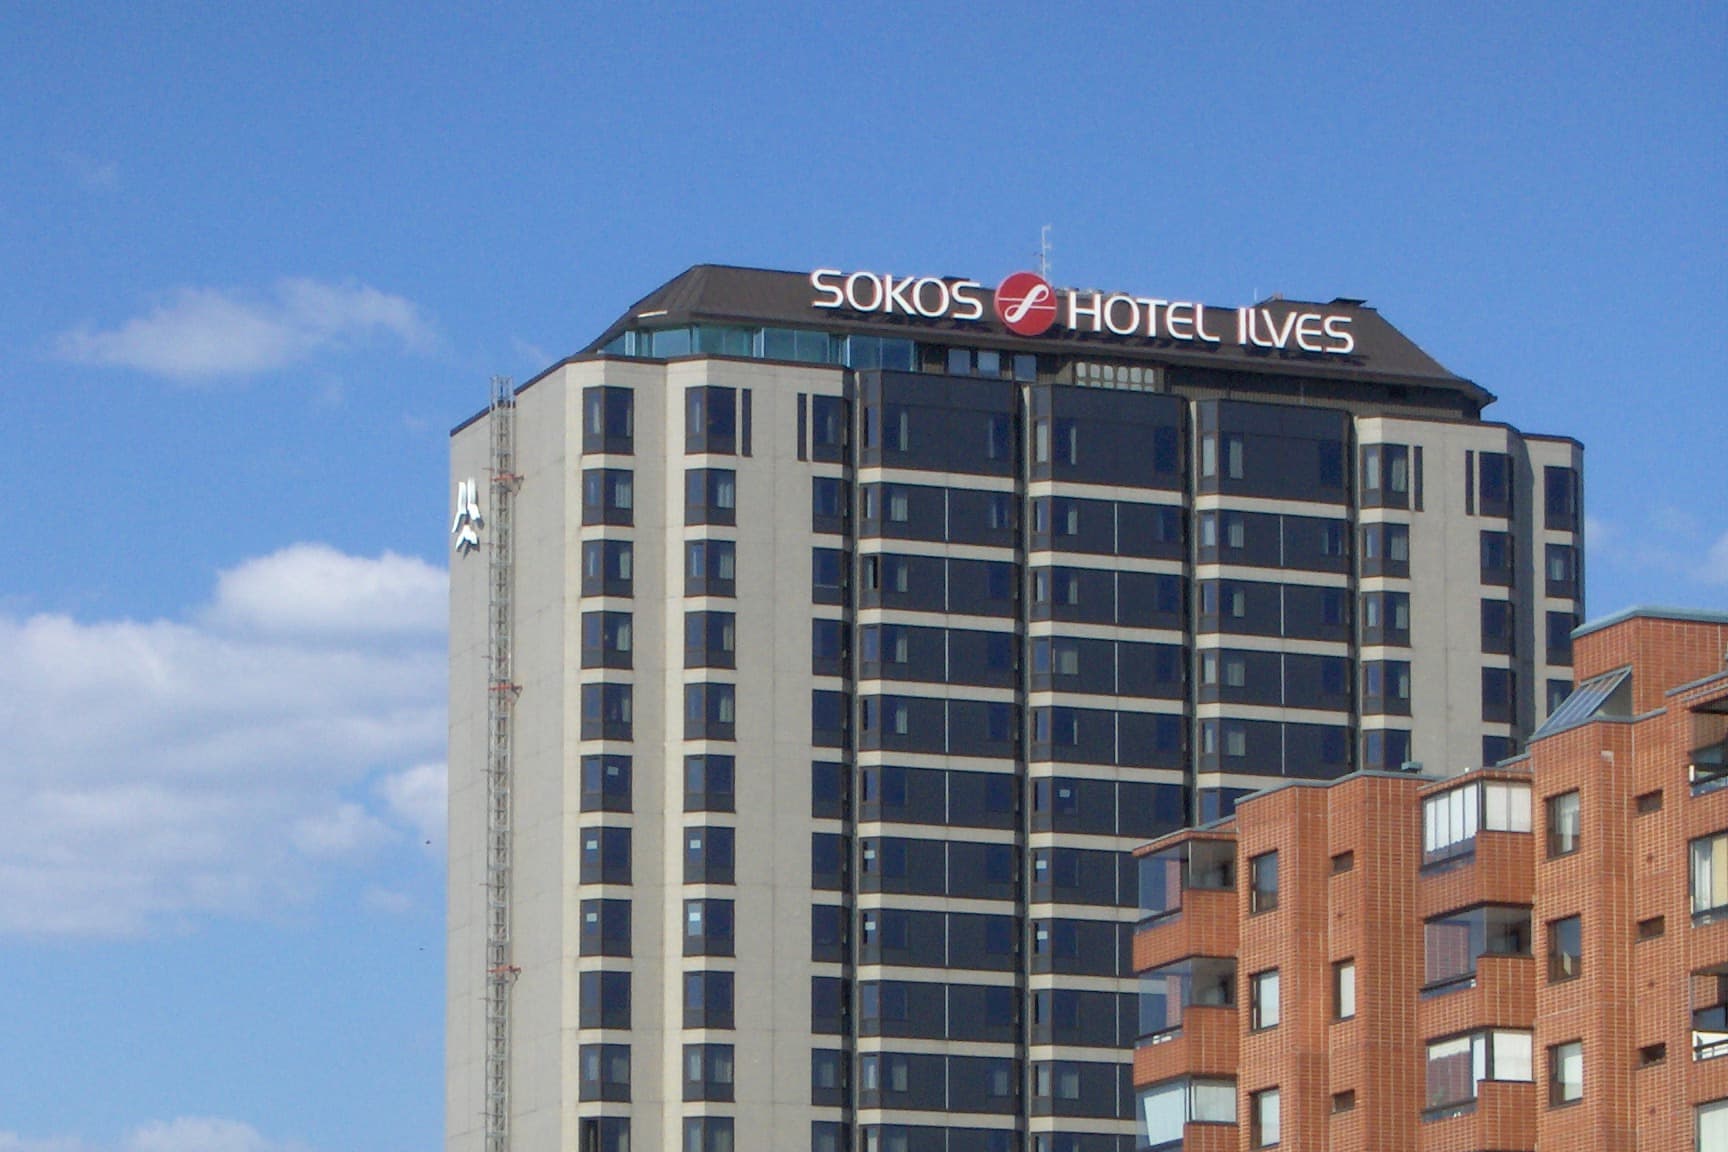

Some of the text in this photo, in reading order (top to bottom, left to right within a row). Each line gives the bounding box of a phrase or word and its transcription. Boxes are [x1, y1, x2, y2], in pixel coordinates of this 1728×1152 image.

[811, 268, 1355, 355] SOKOS HOTEL ILVES
